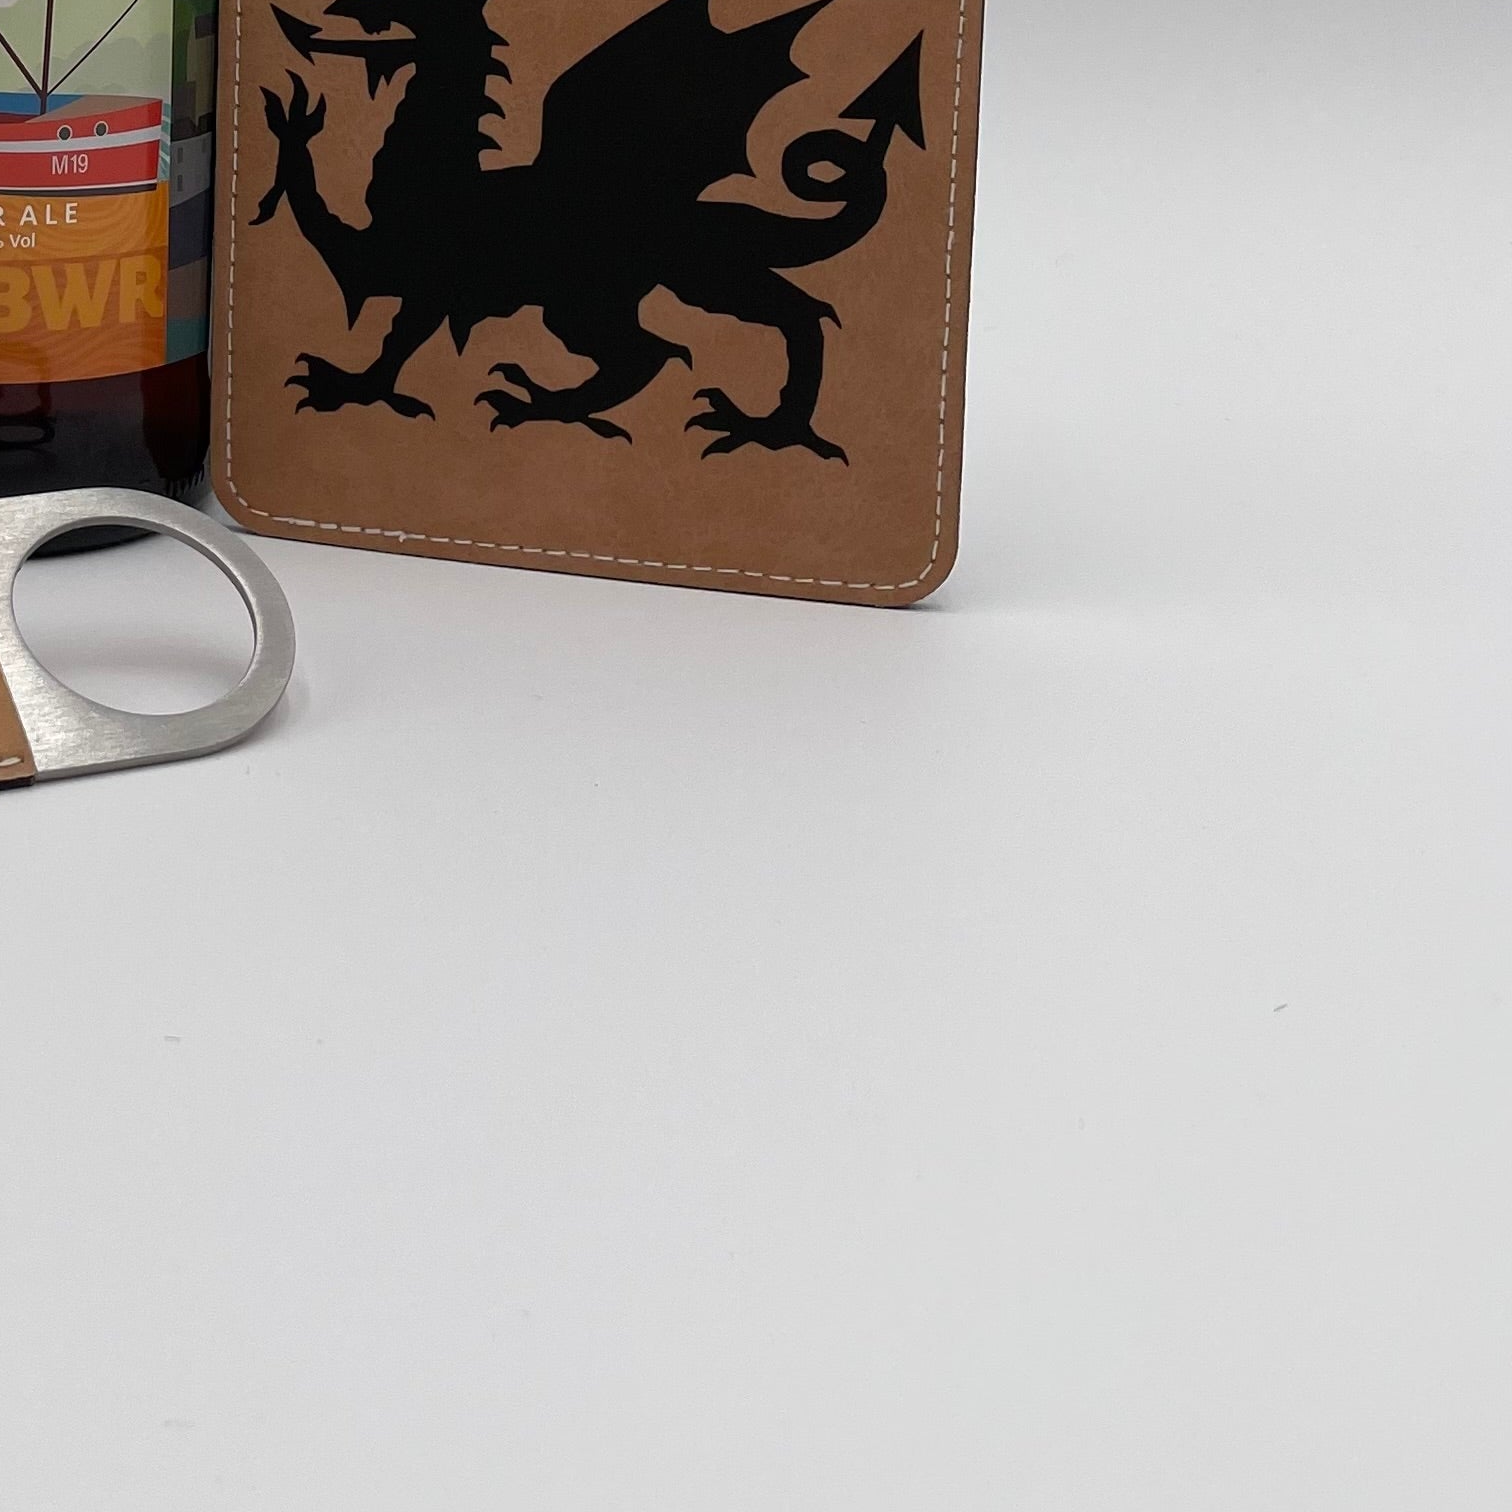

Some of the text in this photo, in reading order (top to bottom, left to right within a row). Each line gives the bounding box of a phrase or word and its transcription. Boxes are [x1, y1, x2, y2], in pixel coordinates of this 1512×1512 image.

[50, 153, 90, 176] M19
[18, 201, 80, 226] ALE
[9, 231, 37, 249] Vol
